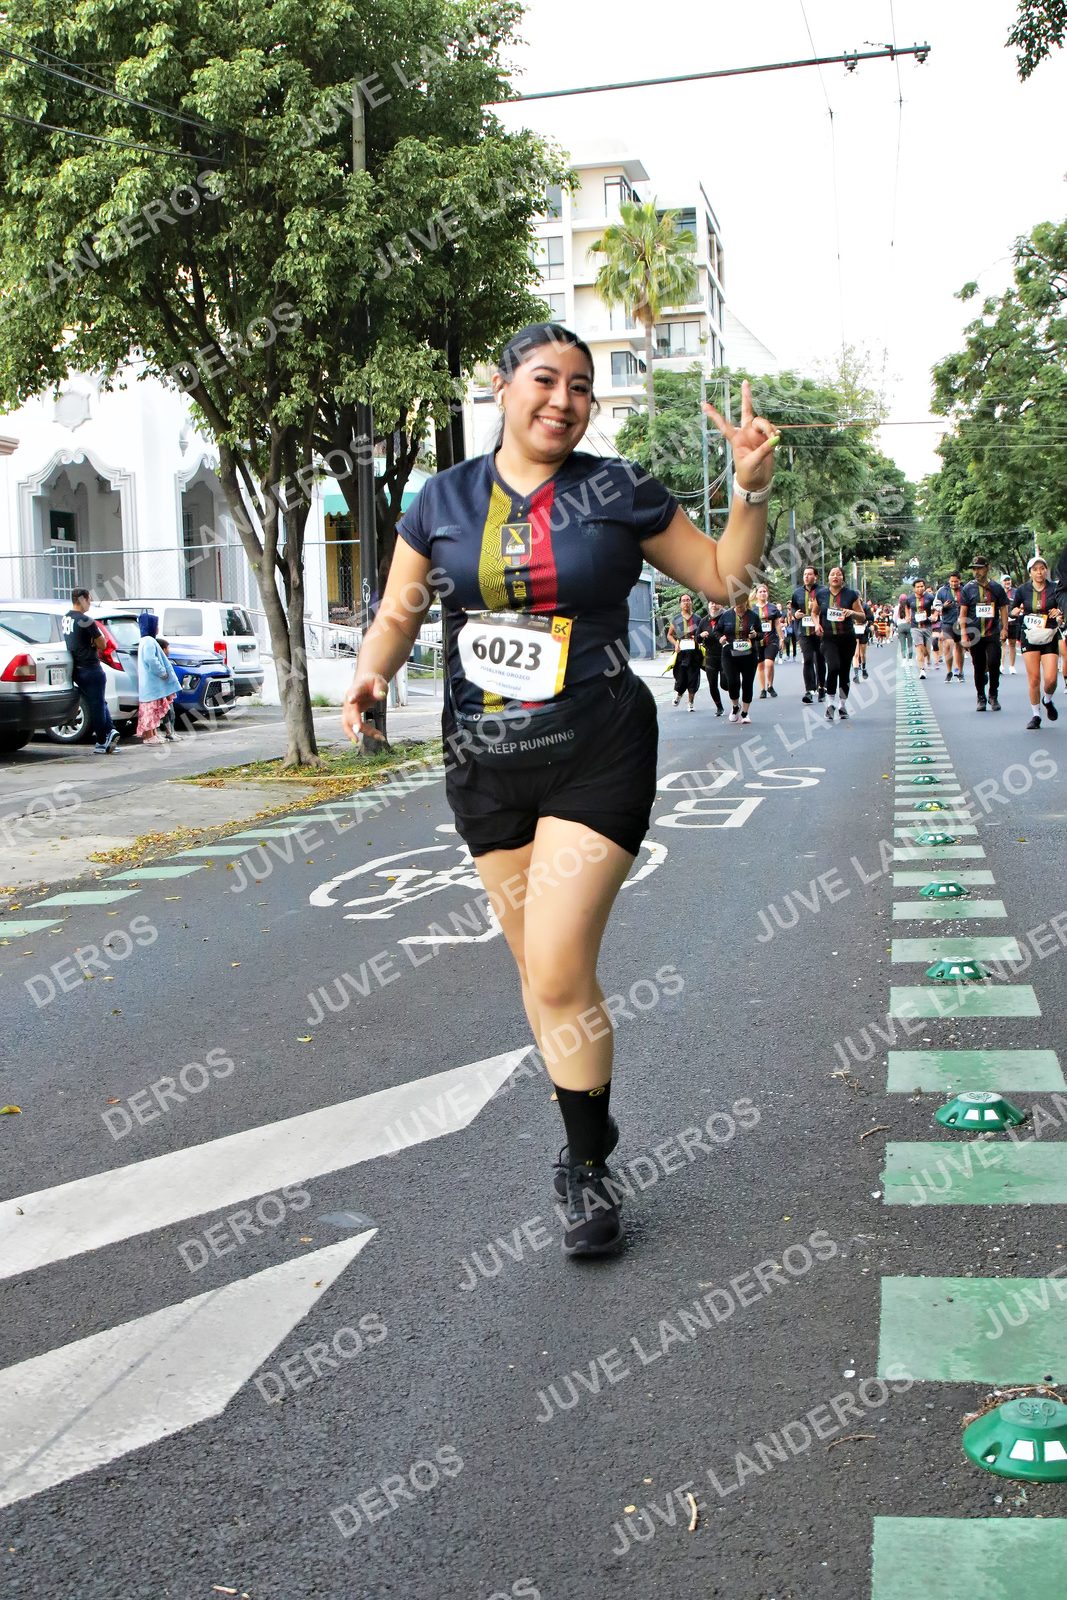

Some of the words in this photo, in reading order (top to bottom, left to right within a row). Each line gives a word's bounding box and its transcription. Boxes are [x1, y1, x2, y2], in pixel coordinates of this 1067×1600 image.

[472, 634, 542, 672] 6023
[487, 741, 518, 755] KEEP
[521, 729, 575, 751] RUNNING
